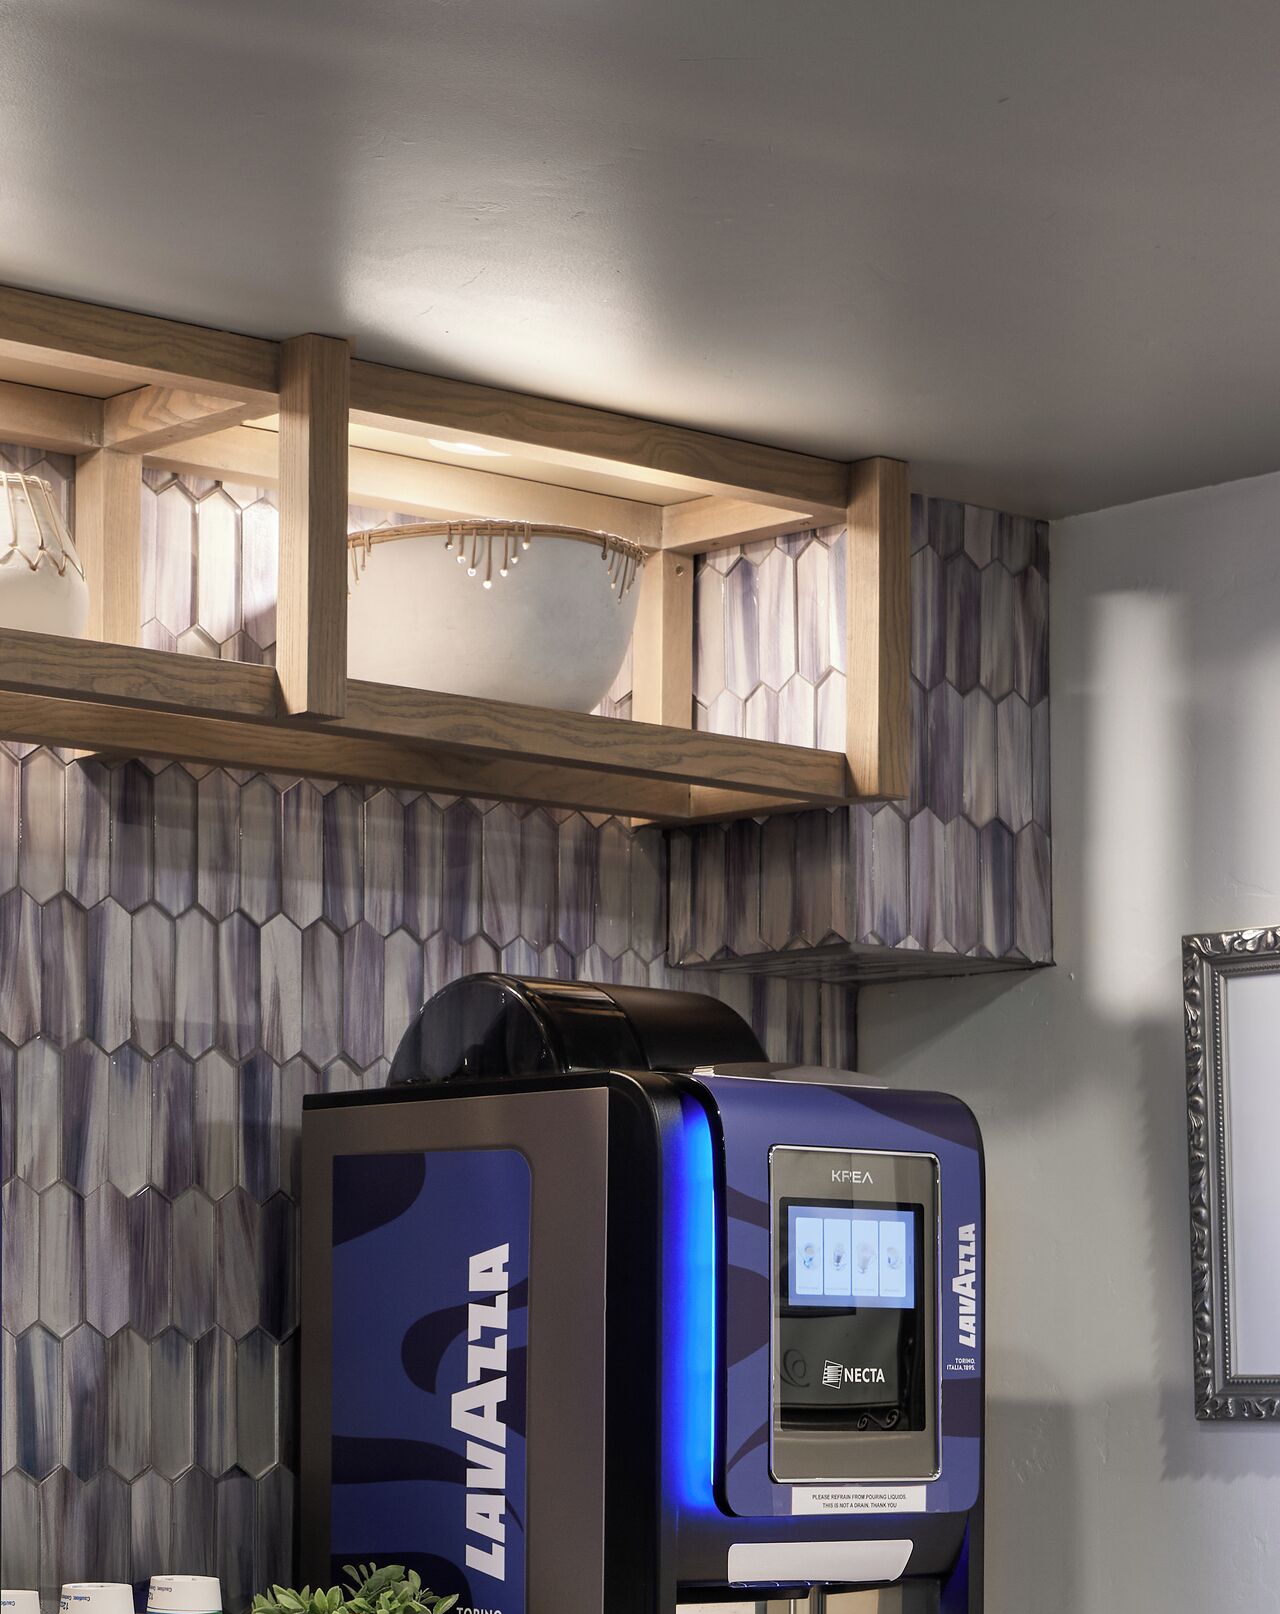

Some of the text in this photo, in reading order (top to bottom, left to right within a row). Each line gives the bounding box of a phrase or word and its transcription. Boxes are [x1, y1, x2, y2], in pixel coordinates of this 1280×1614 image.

[831, 1169, 874, 1184] KREA
[951, 1222, 976, 1348] LAVAZZA
[844, 1367, 886, 1383] NECTA
[450, 1242, 510, 1581] LAVAZZA
